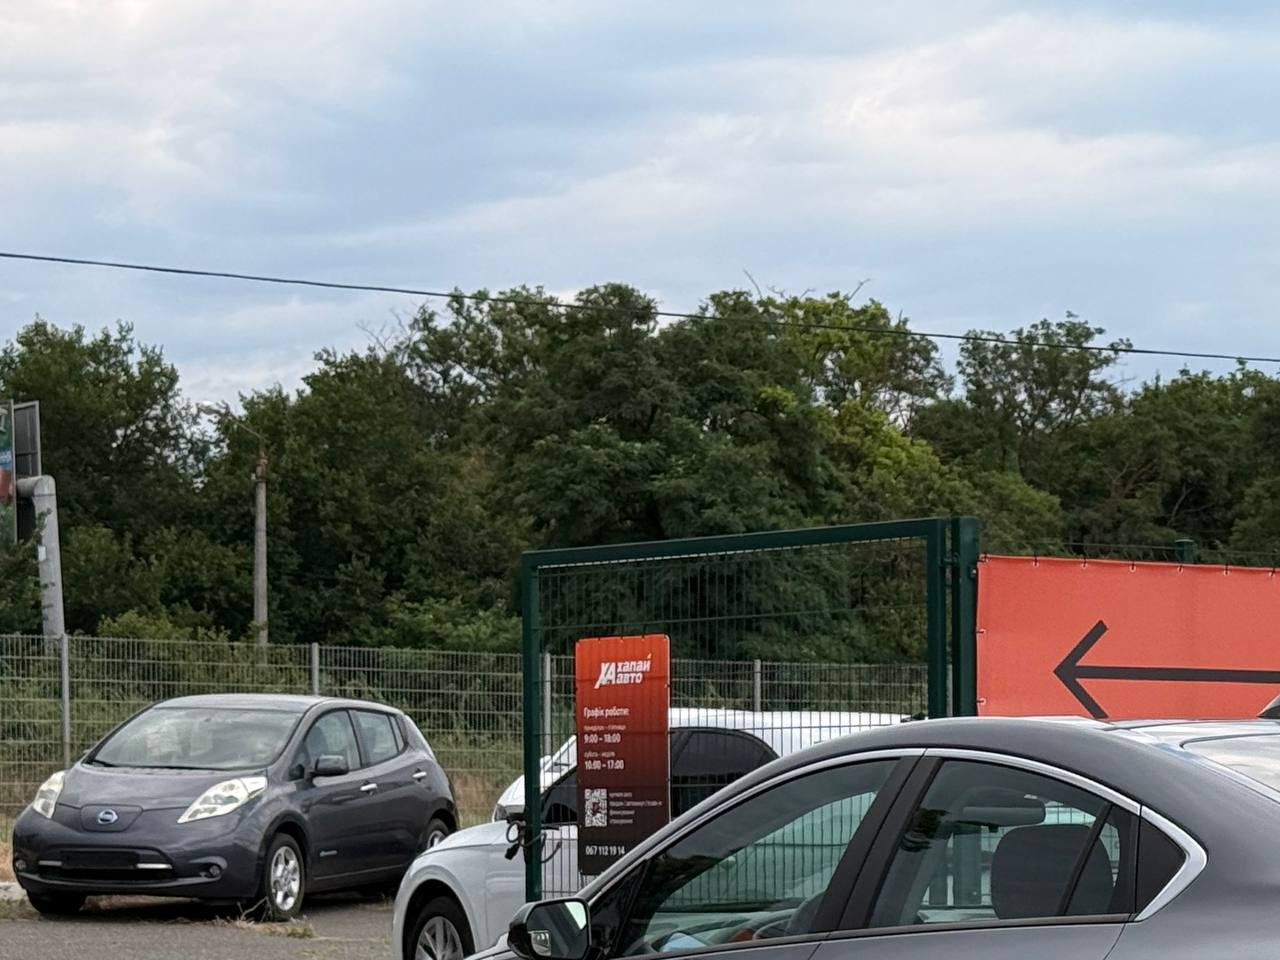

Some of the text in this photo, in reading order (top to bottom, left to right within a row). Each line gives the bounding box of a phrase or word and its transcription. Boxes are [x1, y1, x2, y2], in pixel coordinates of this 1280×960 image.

[616, 672, 643, 685] авто
[585, 845, 598, 855] 067
[598, 845, 608, 855] 112
